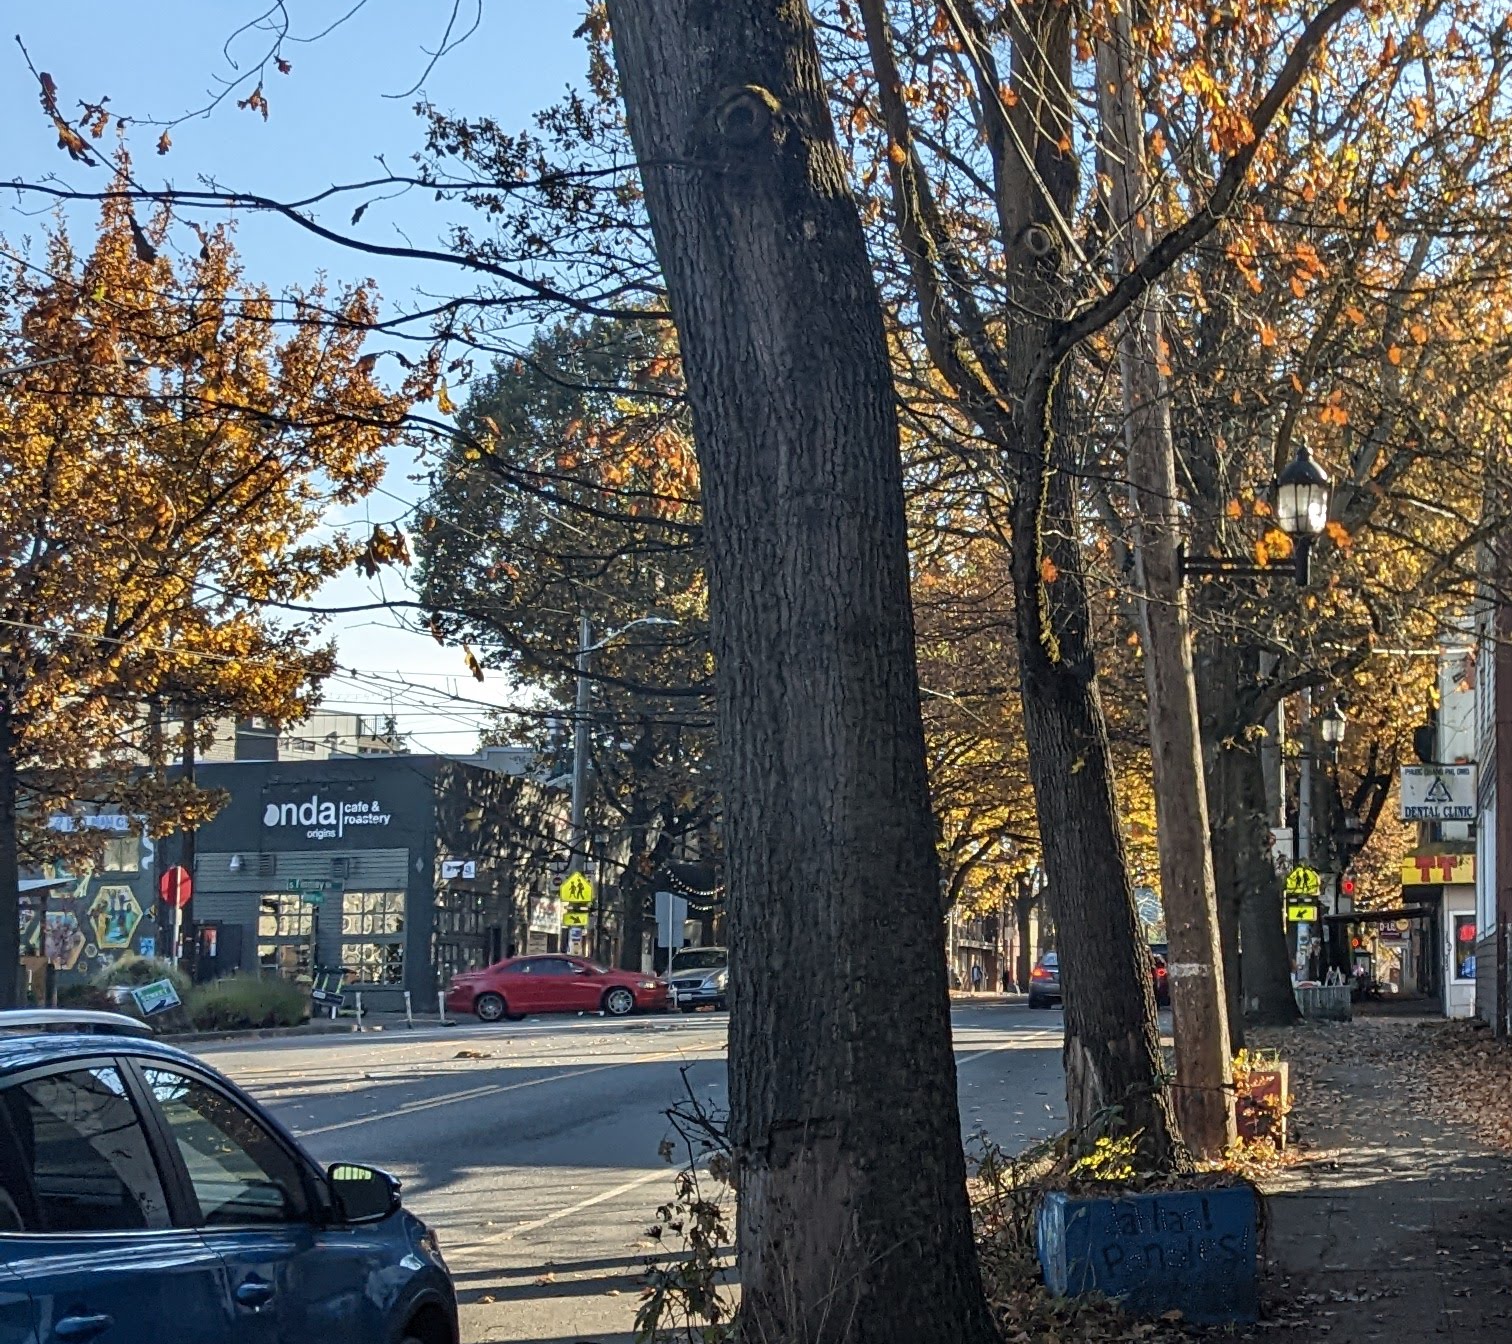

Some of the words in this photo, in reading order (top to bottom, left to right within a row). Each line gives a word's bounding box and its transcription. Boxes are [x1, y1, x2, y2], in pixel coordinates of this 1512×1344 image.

[263, 794, 338, 827] onda
[344, 801, 369, 813] cafe
[371, 800, 381, 813] &
[1404, 806, 1440, 818] DENTAL
[1443, 805, 1473, 818] CLINIC
[343, 814, 392, 825] roastery
[306, 828, 337, 840] origins
